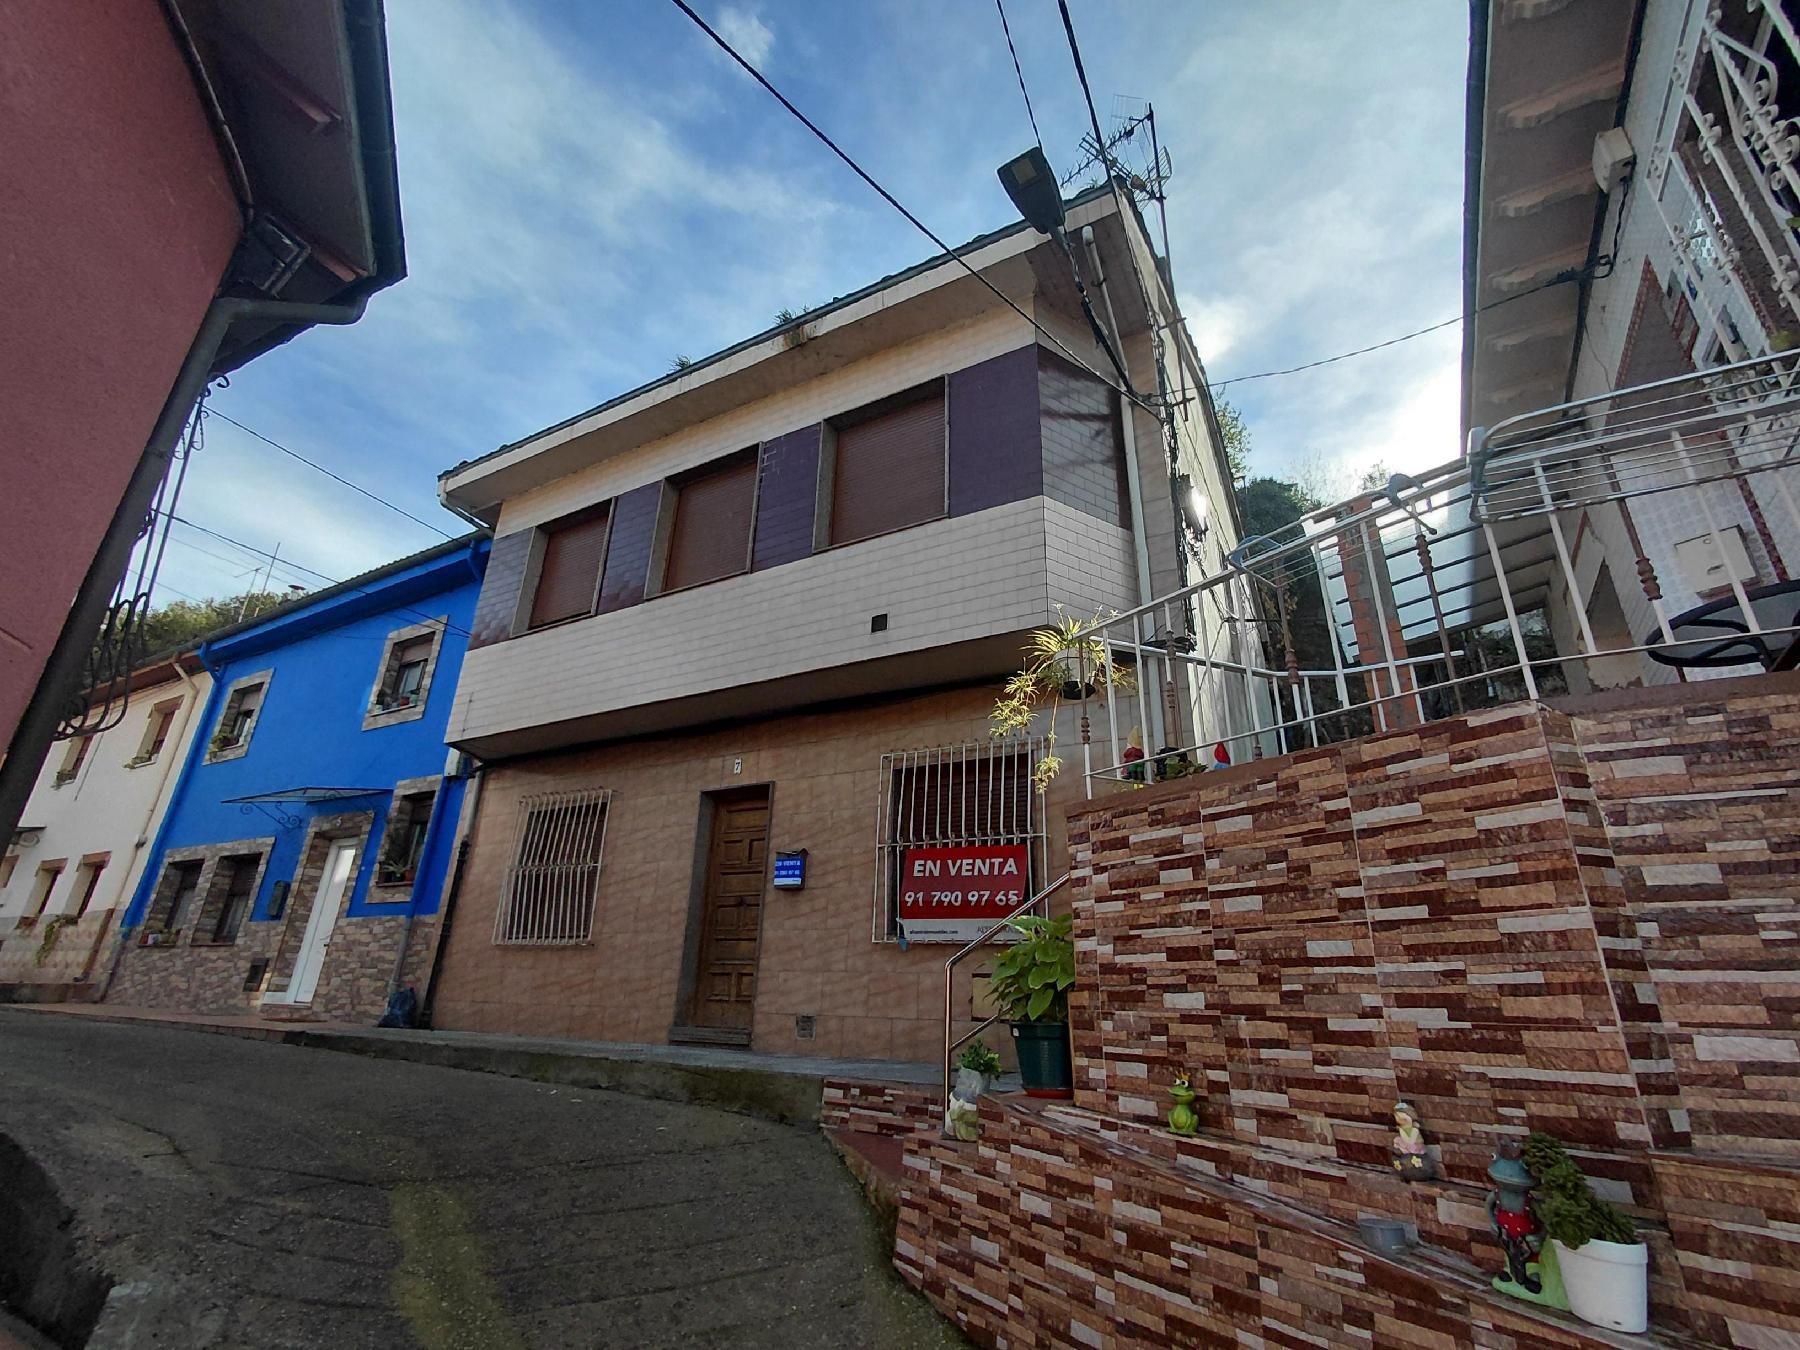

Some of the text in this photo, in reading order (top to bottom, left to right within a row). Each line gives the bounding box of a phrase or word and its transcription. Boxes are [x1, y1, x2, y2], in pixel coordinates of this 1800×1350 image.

[913, 857, 1018, 877] EN VENTA
[904, 890, 1019, 907] 91 790 97 65
